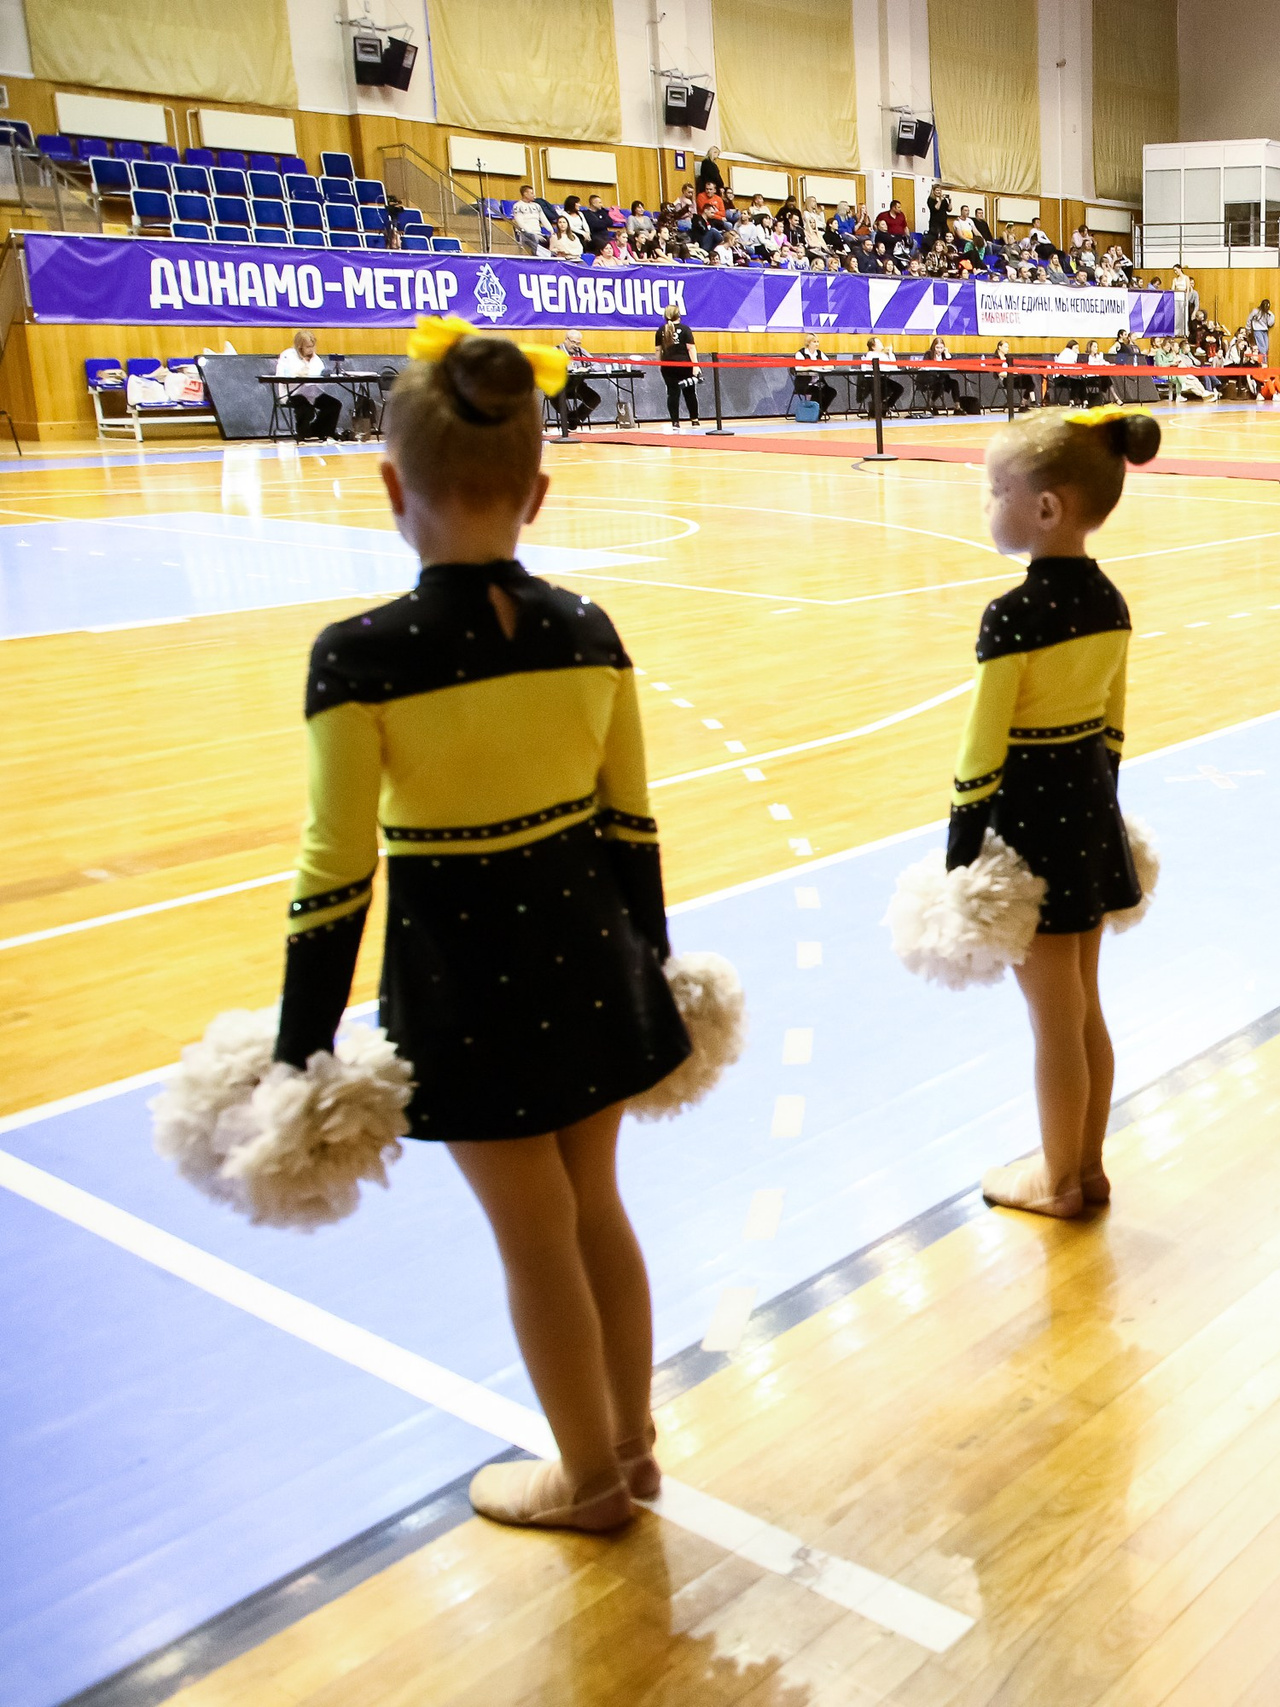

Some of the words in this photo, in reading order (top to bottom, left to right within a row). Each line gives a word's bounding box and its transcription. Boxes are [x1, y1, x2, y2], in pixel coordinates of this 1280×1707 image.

[150, 258, 458, 311] ДИНАМО-МЕТАР
[518, 273, 687, 316] ЧЕЛЯБИНСК
[1004, 294, 1019, 310] МЫ
